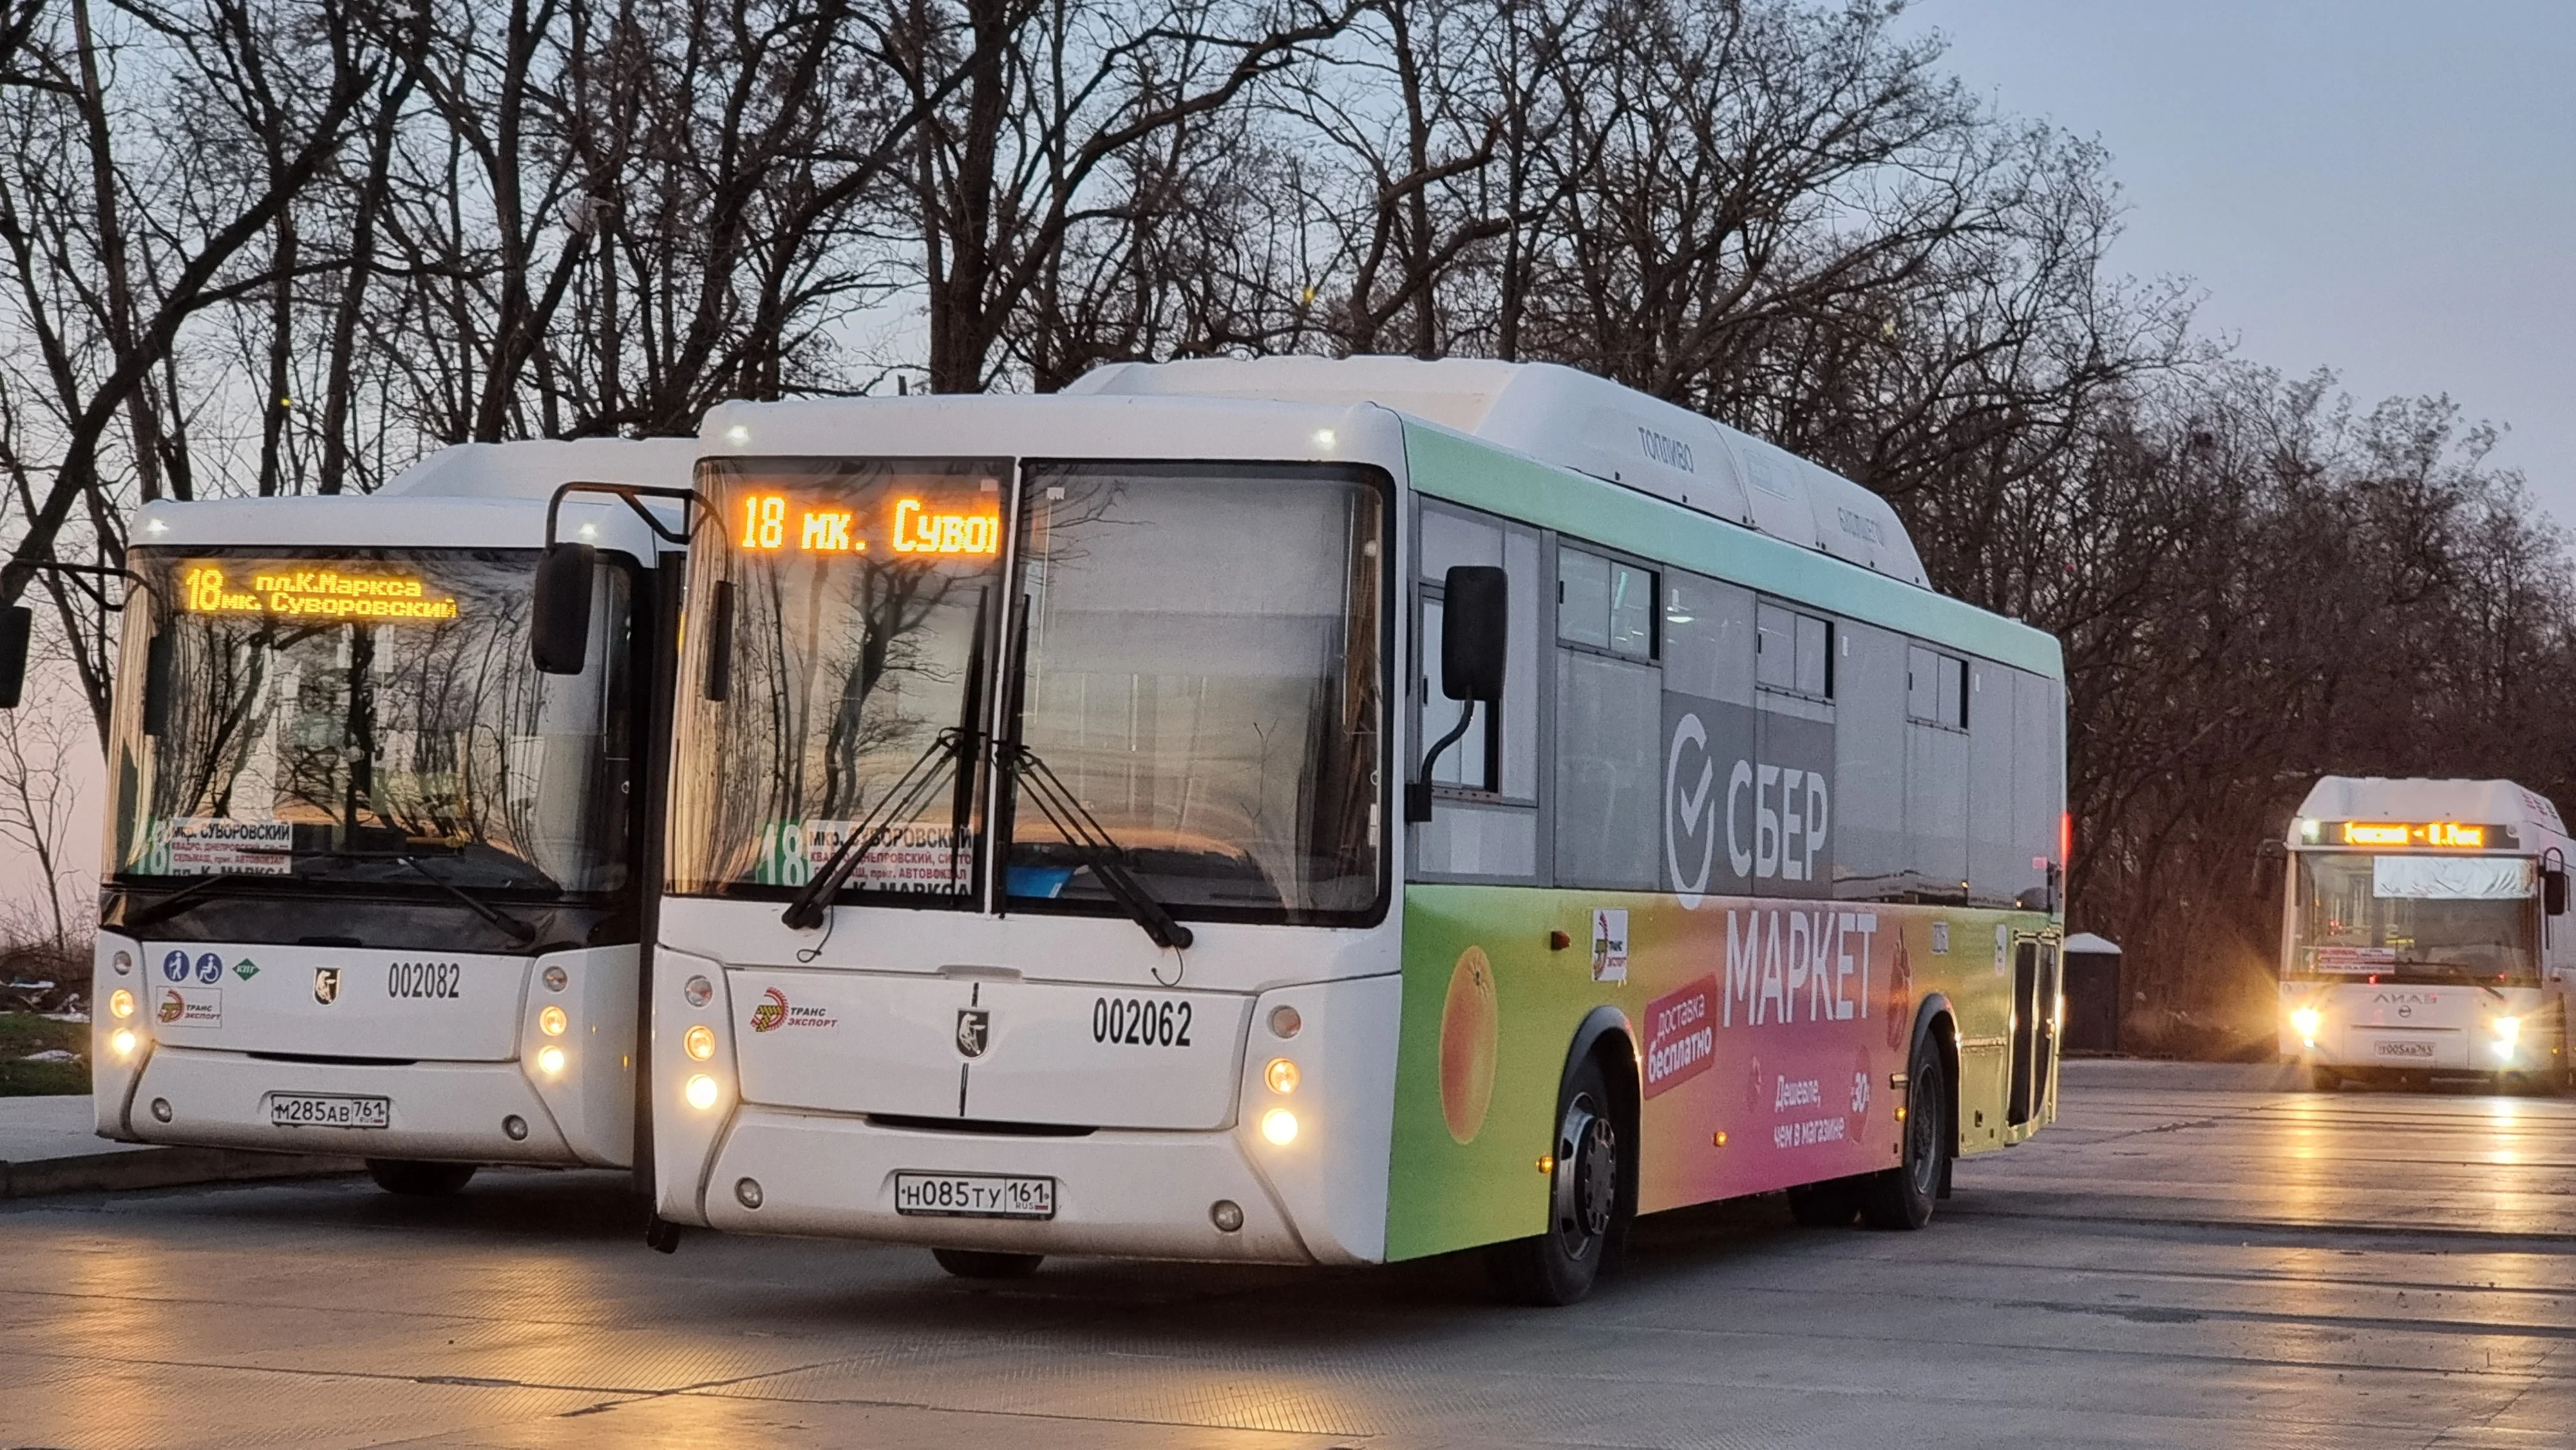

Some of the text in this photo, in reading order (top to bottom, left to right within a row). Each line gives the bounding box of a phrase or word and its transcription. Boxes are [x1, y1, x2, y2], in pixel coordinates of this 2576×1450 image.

[1638, 426, 1694, 474] ТОПЛИВО
[742, 496, 786, 549] 18
[801, 513, 866, 550] мк.
[186, 568, 224, 610] 18
[221, 591, 457, 617] мк. Суворовский
[1727, 758, 1828, 881] СБЕР
[759, 824, 805, 887] 18
[860, 851, 935, 866] НЕПРОВСКИЙ,
[388, 963, 460, 999] 002082
[1723, 909, 1877, 1028] МАРКЕТ
[186, 1004, 213, 1012] ТРАНС
[787, 1018, 838, 1028] ЭКСПОРТ
[790, 1007, 827, 1017] ТРАНС
[1094, 997, 1192, 1047] 002062
[1656, 993, 1705, 1041] доставка
[1648, 1026, 1712, 1084] бесплатно
[1774, 1075, 1821, 1113] Дешевле,
[1774, 1116, 1845, 1149] чем в магазине
[907, 1180, 1044, 1208] Н085ТУ 161
